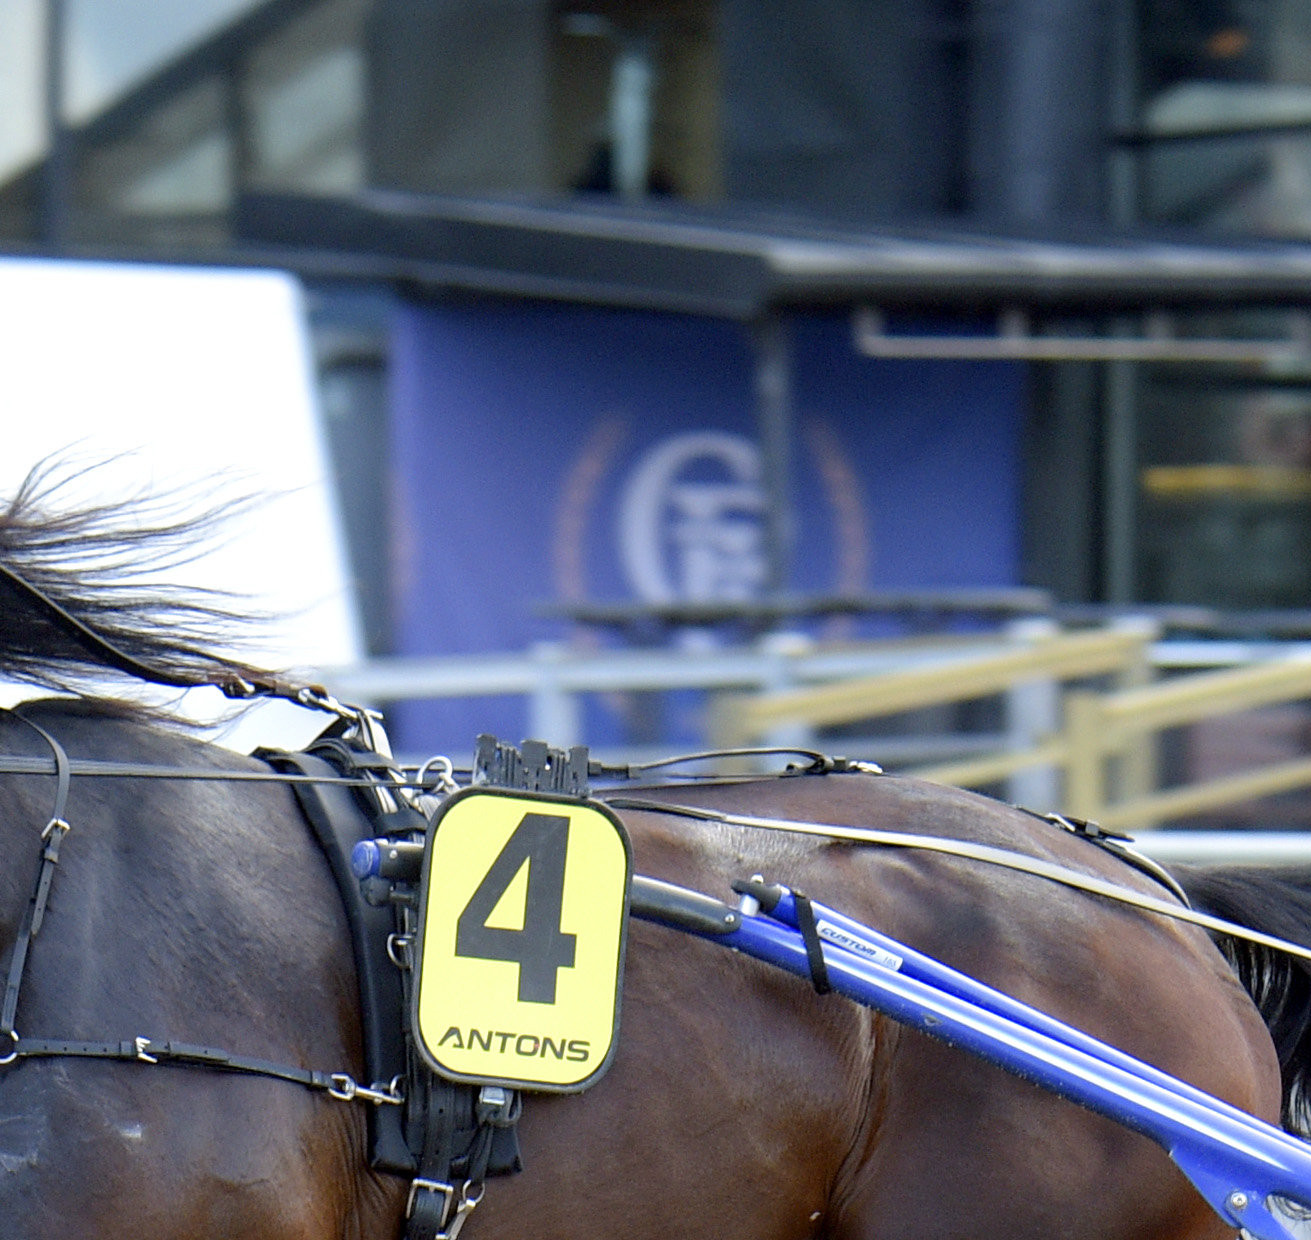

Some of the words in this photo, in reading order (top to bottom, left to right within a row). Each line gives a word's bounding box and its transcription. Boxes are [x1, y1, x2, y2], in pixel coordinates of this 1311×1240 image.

[454, 812, 577, 1005] 4
[820, 927, 877, 956] CUSTOM
[438, 1026, 590, 1062] ANTONS
